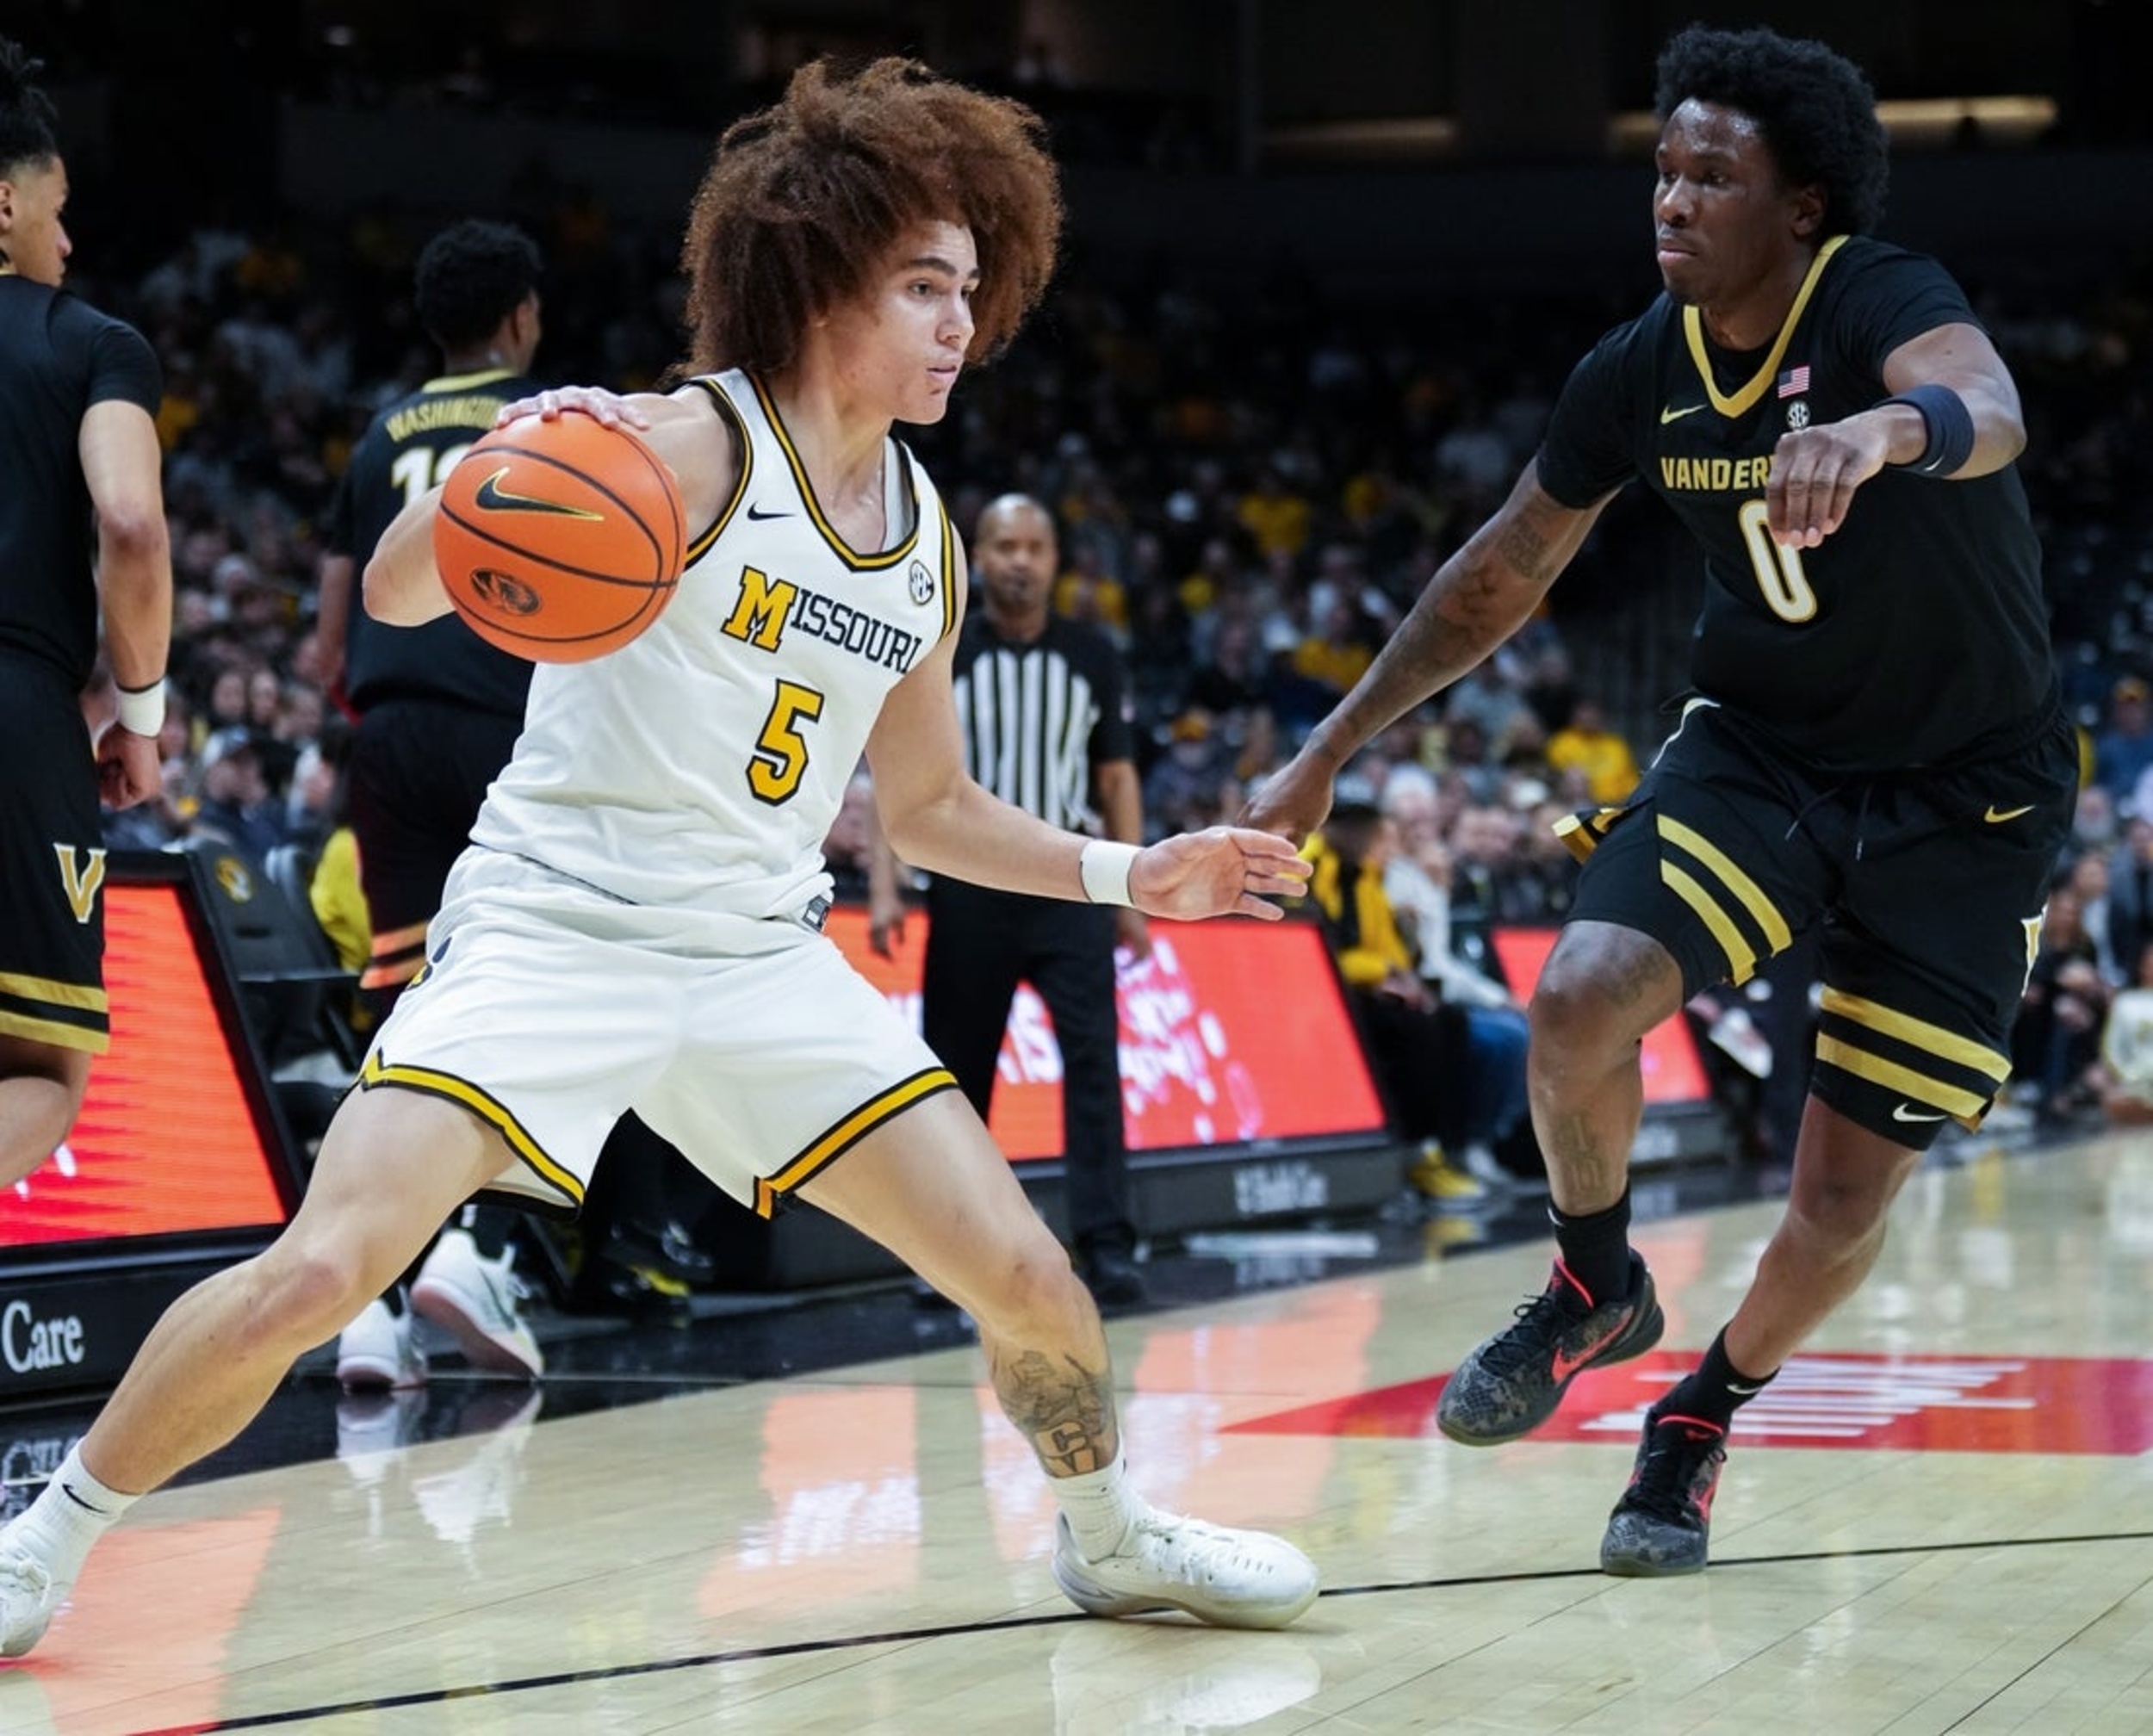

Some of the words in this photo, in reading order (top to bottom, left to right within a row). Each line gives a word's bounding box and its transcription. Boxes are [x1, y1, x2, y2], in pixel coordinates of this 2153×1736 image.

[1660, 455, 1778, 490] VANDER
[1739, 499, 1817, 623] 0
[721, 565, 921, 674] MISSOURI
[746, 679, 824, 807] 5
[53, 842, 108, 923] V
[2, 1300, 84, 1373] Care
